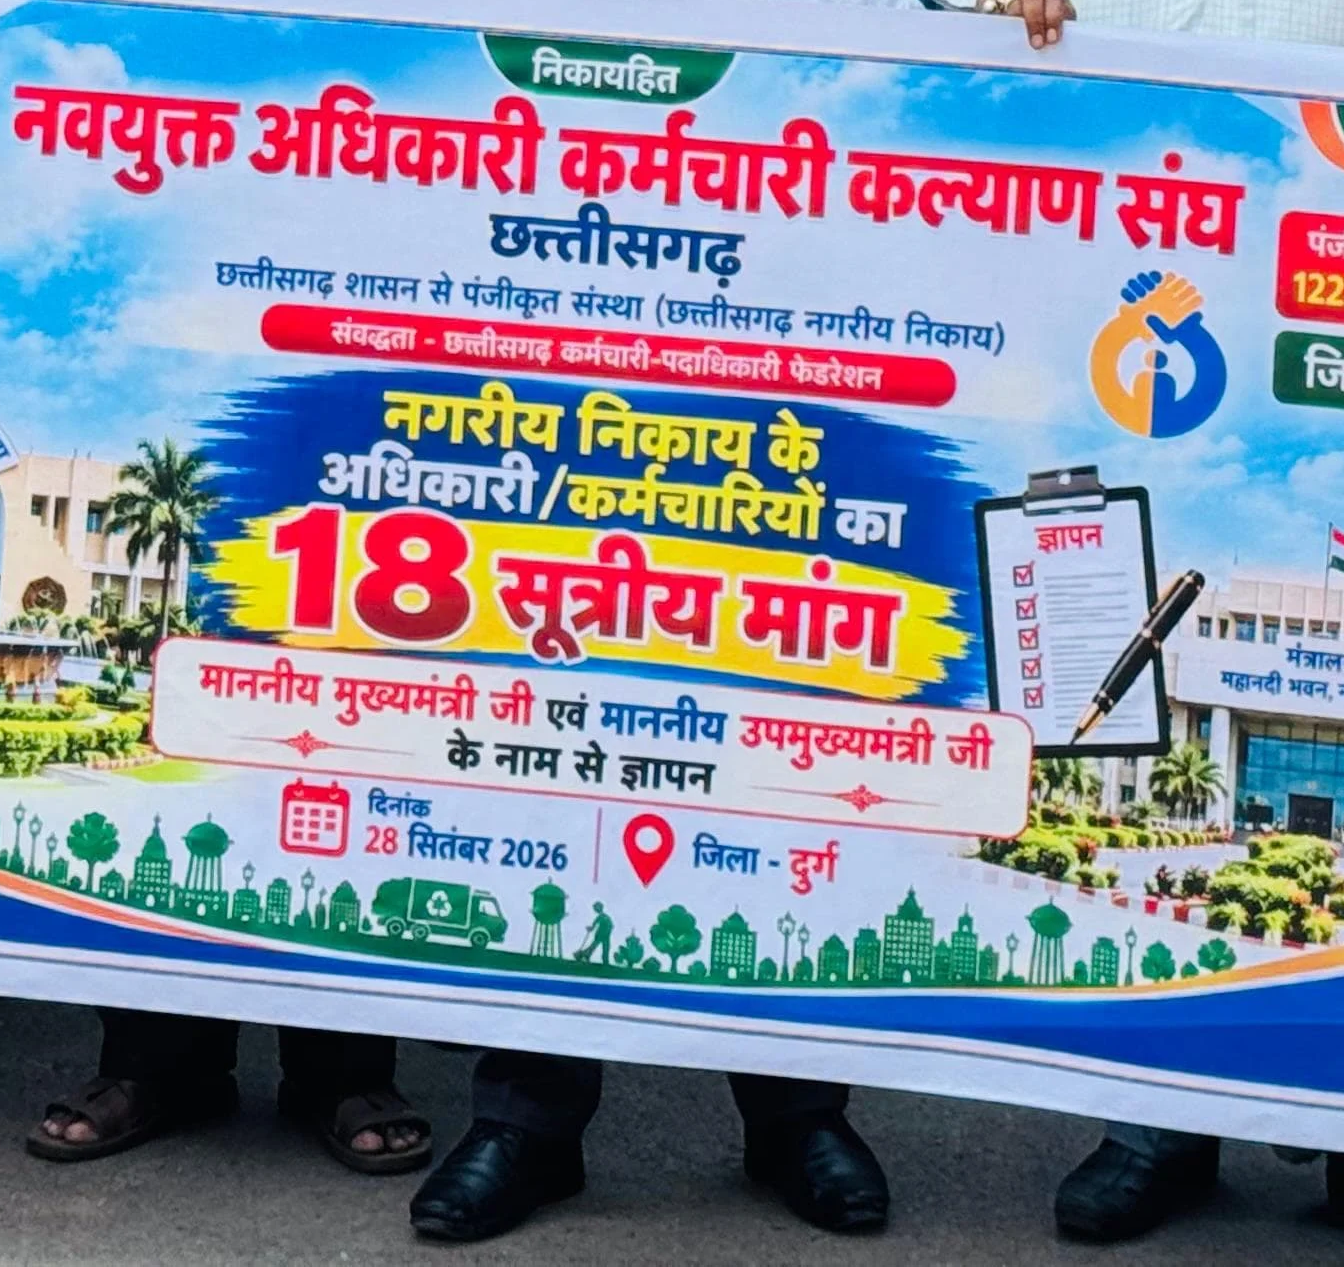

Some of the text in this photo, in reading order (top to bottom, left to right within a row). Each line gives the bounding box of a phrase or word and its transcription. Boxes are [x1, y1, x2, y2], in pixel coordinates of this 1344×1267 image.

[532, 45, 681, 95] निकायहित
[12, 83, 1246, 255] नवयुक्त अधिकारी कर्मचारी कल्याण संघ
[489, 201, 745, 289] छत्तीसगढ़
[215, 256, 336, 299] छत्तीसगढ़
[345, 271, 421, 302] शासन
[429, 270, 452, 306] से
[462, 275, 560, 319] पंजीकृत
[572, 284, 644, 322] संस्था
[804, 305, 895, 343] नगरीय
[905, 310, 1005, 357] निकाय)
[444, 325, 553, 366] छत्तीसगढ़
[560, 336, 783, 383] कर्मचारी-पदाधिकारी
[789, 350, 884, 391] फेडरेशन
[383, 381, 824, 474] नगरीय निकाय के
[835, 495, 908, 549] का
[1034, 523, 1105, 554] ज्ञापन
[273, 506, 901, 669] 18 सूत्रीय मांग
[199, 657, 995, 772] माननीय मुख्यमंत्री जी एवं माननीय उपमुख्यमंत्री जी
[447, 728, 716, 794] के नाम से ज्ञापन
[367, 786, 433, 819] दिनांक
[364, 821, 569, 872] 28 सितंबर 2026
[692, 833, 760, 874] जिला
[788, 840, 840, 894] दुर्ग
